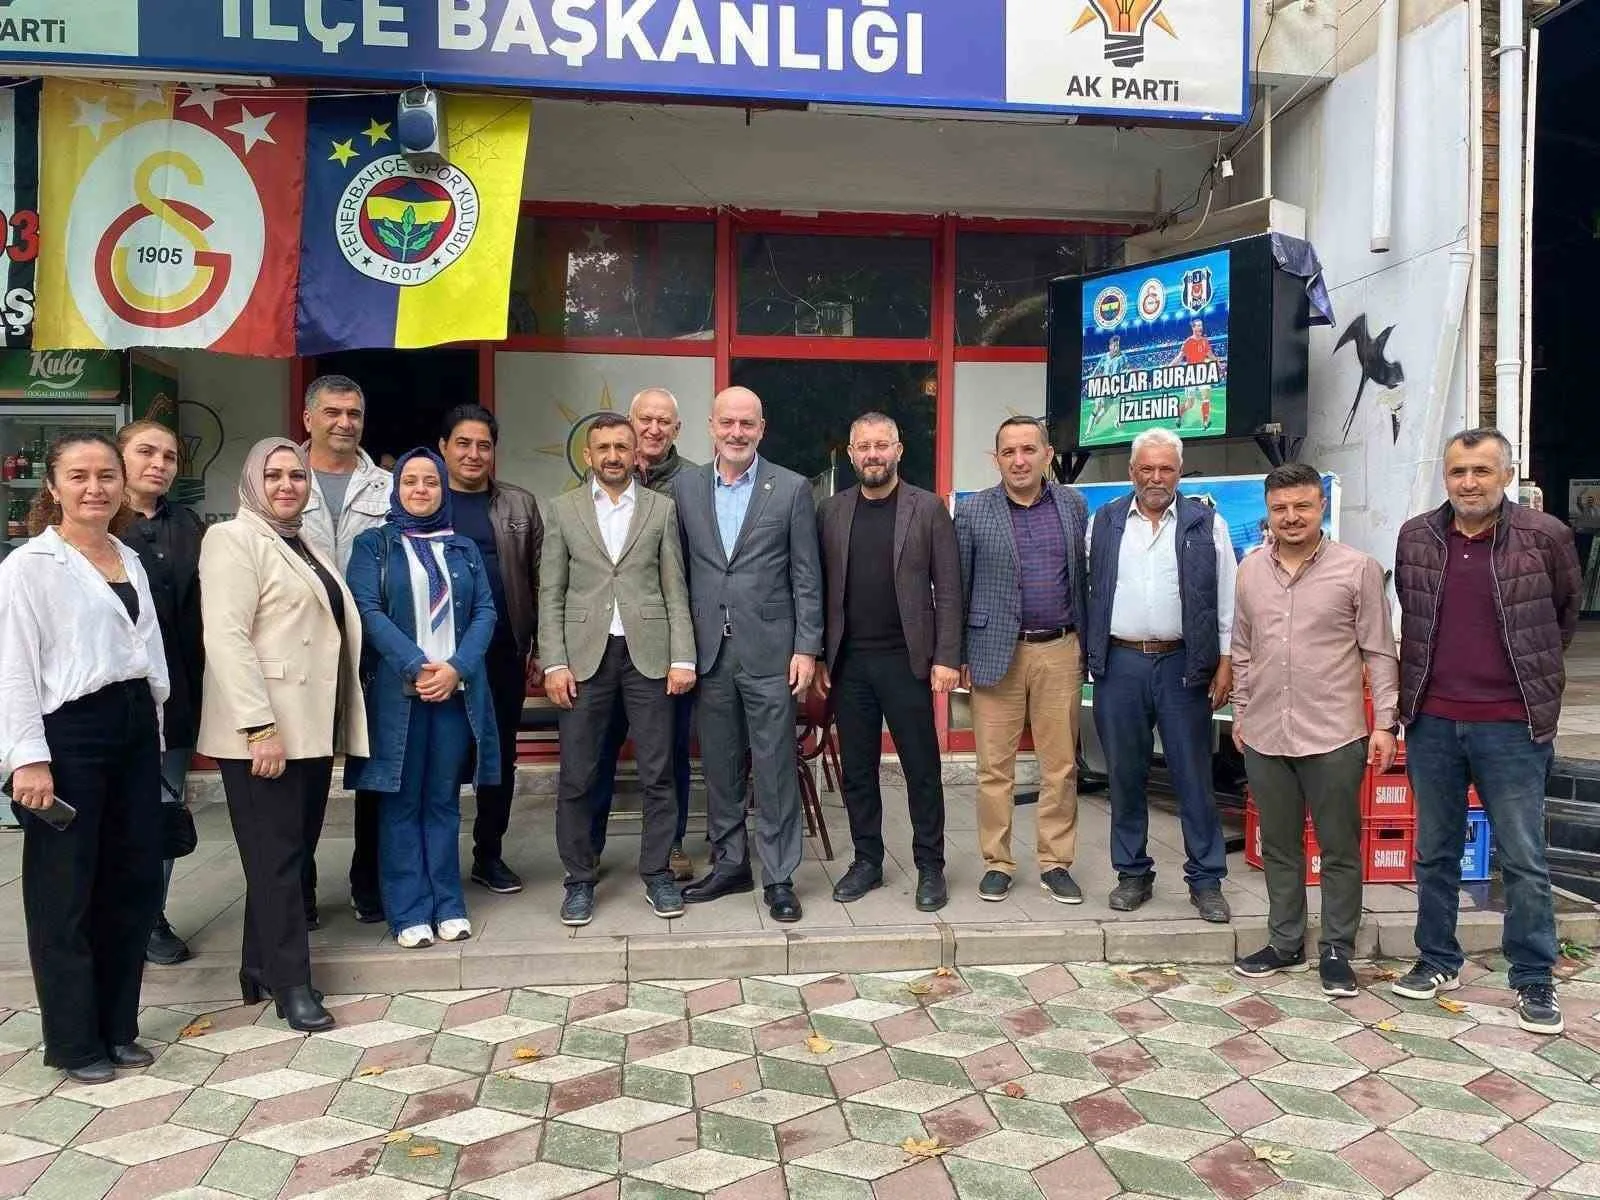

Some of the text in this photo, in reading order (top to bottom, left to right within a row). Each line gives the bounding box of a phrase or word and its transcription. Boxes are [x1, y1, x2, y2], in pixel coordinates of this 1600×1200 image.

[0, 18, 65, 43] ARTi
[438, 0, 923, 74] BAŞKANLIĞI
[1066, 75, 1102, 98] AK
[340, 158, 475, 258] FENERBAHÇE SPOR KULÜBÜ
[137, 246, 183, 265] 1905
[380, 263, 423, 281] 1907
[29, 350, 86, 379] Kula
[1088, 362, 1219, 398] MAÇLAR BURADA
[1120, 394, 1179, 421] İZLENİR
[1375, 786, 1407, 804] SARIKIZ
[1374, 850, 1406, 868] SARIKIZ
